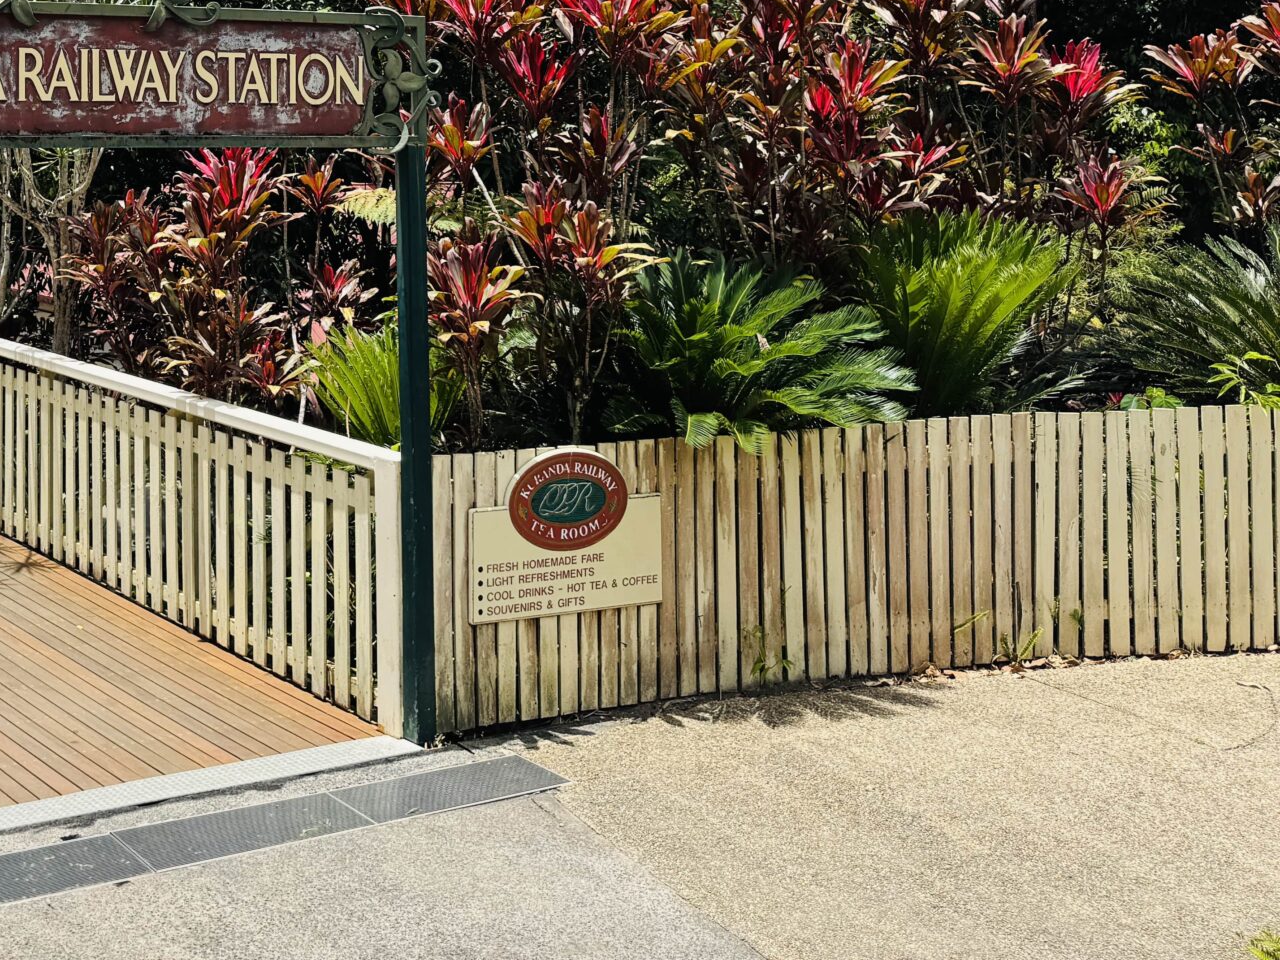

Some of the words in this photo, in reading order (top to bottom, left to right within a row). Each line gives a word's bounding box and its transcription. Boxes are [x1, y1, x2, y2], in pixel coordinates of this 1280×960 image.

[18, 47, 186, 104] RAILWAY
[194, 49, 366, 107] STATION
[574, 462, 618, 492] RAILWAY
[486, 560, 519, 574] FRESH
[522, 555, 578, 570] HOMEMADE
[581, 552, 605, 564] FARE
[486, 575, 515, 588] LIGHT
[518, 567, 595, 585] REFRESHMENTS
[486, 591, 515, 602] COOL
[518, 586, 554, 599] DRINKS
[567, 582, 586, 594] HOT
[589, 578, 608, 590] TEA
[611, 578, 618, 588] &
[622, 574, 658, 587] COFFEE
[486, 602, 543, 617] SOUVENIRS
[546, 599, 553, 609] &
[557, 596, 585, 609] GIFTS
